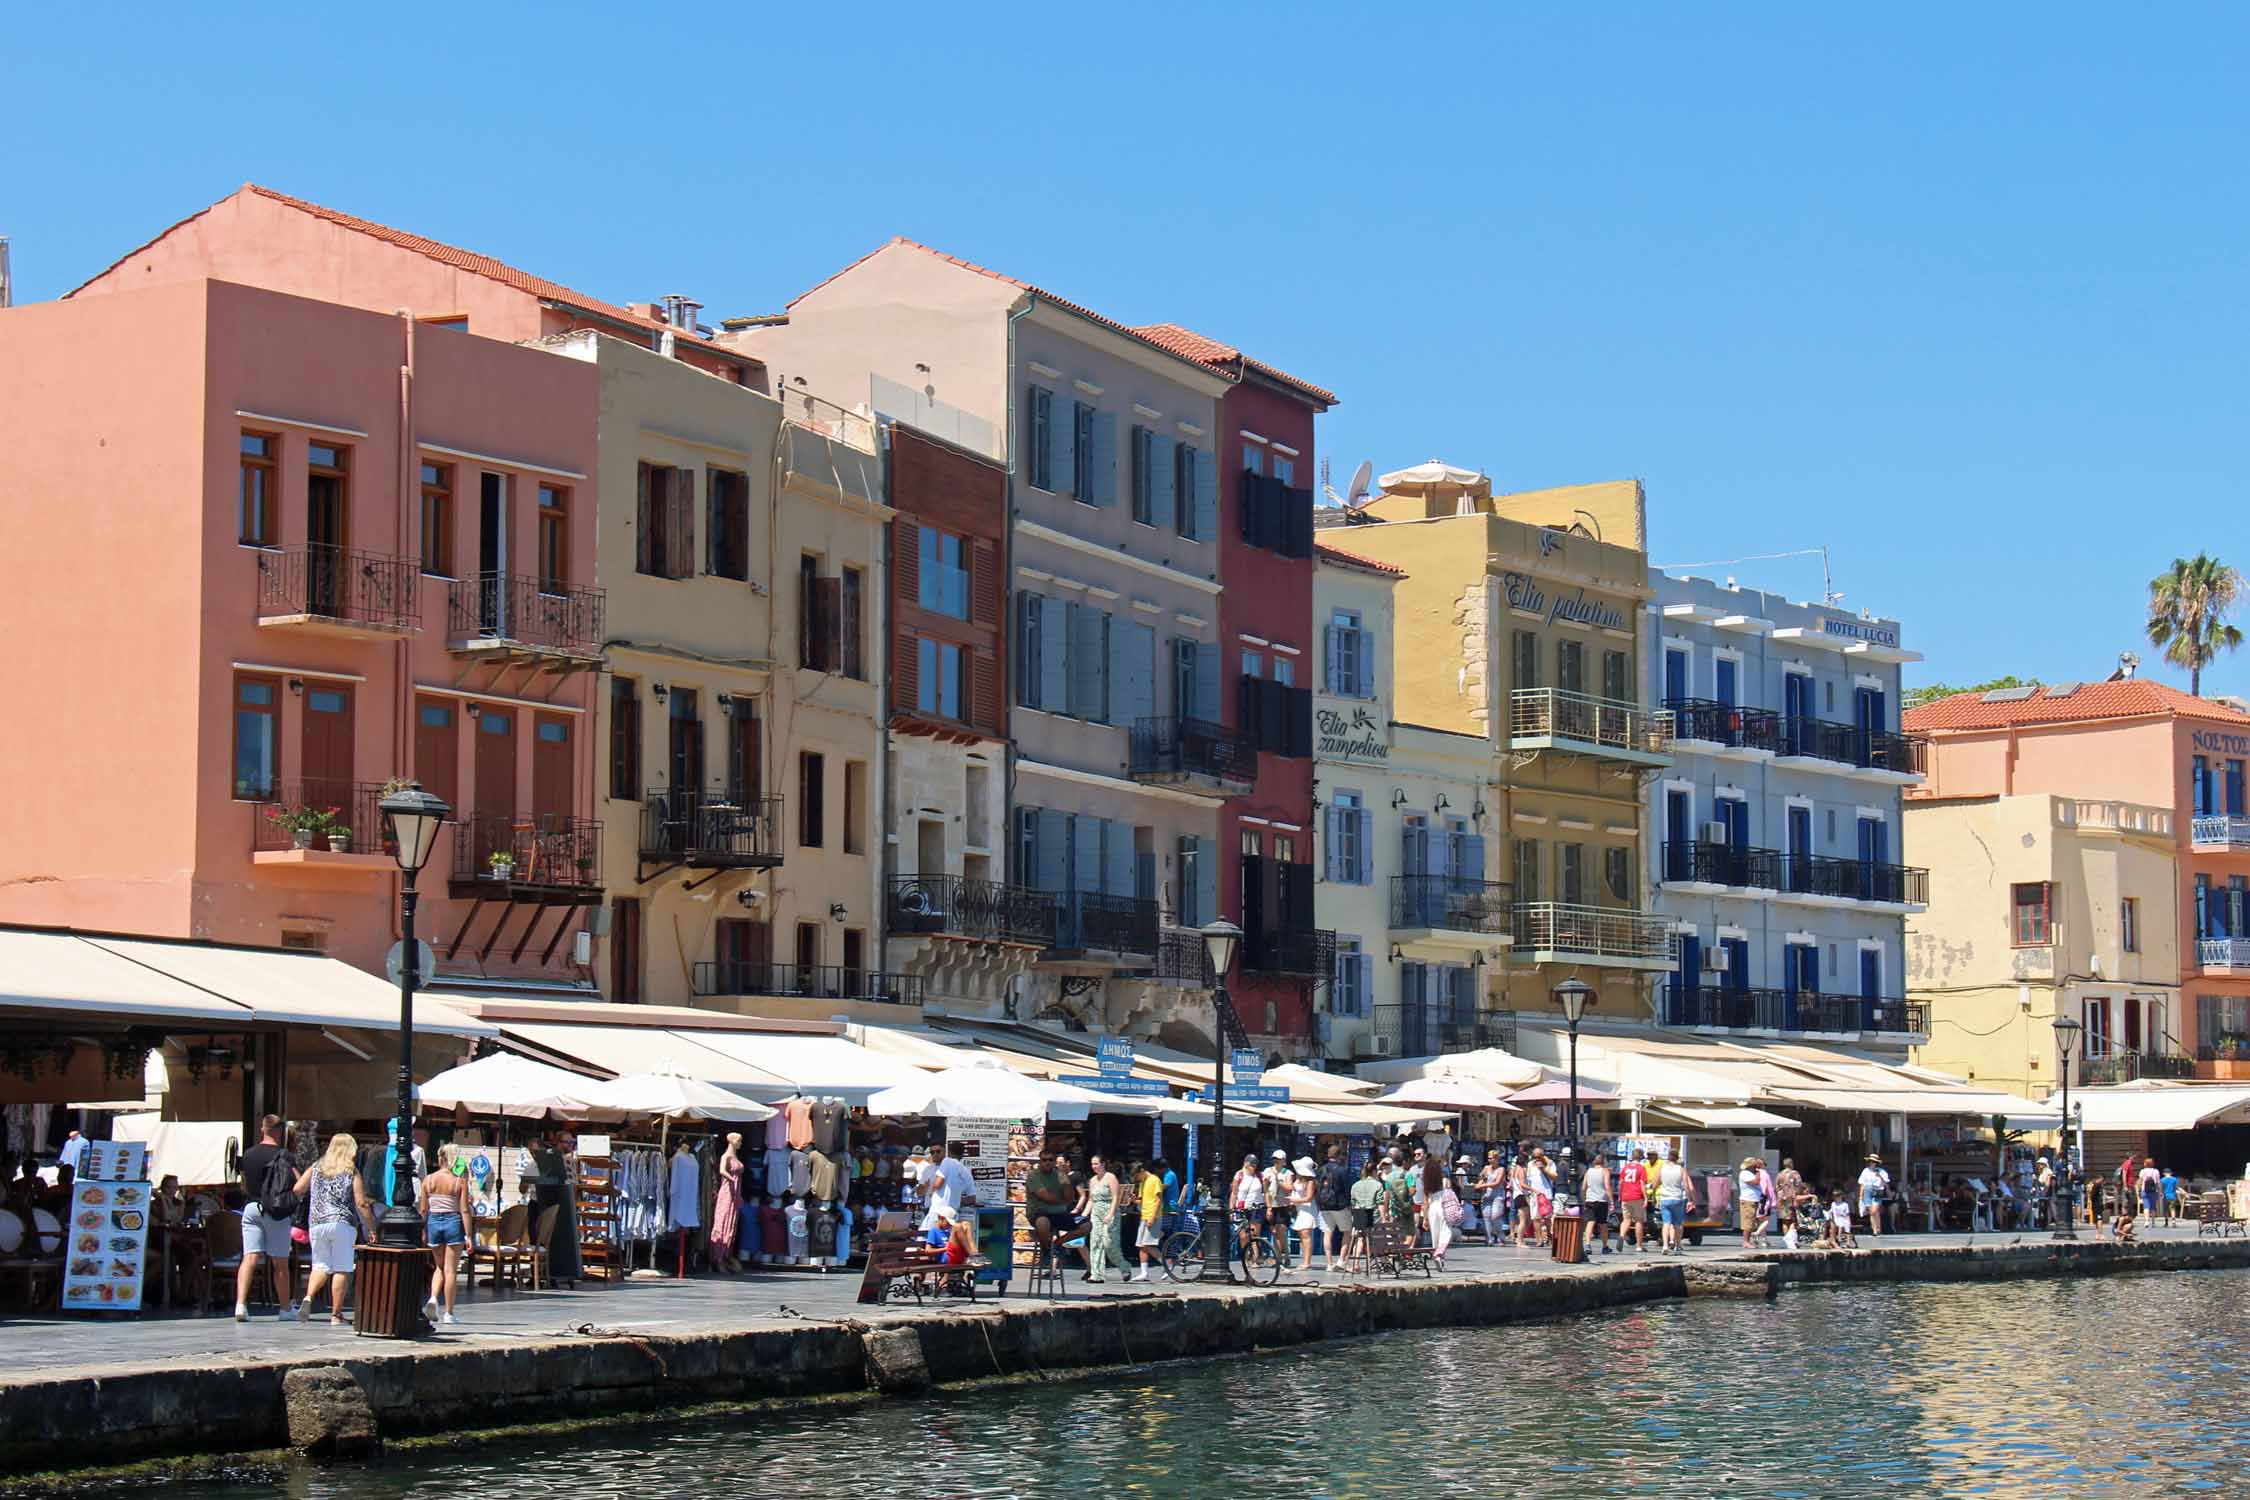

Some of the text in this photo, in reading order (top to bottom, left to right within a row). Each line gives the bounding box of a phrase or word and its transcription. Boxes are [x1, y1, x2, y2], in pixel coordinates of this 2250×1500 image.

[1504, 571, 1625, 628] Elia palatino
[1825, 620, 1896, 645] HOTEL LUCIA
[1317, 710, 1348, 736] Elia
[1318, 731, 1390, 760] zampeliou
[1102, 1043, 1132, 1058] ΔΗΜΟΣ
[1237, 1055, 1260, 1067] DIMOS
[1624, 1168, 1637, 1182] 21
